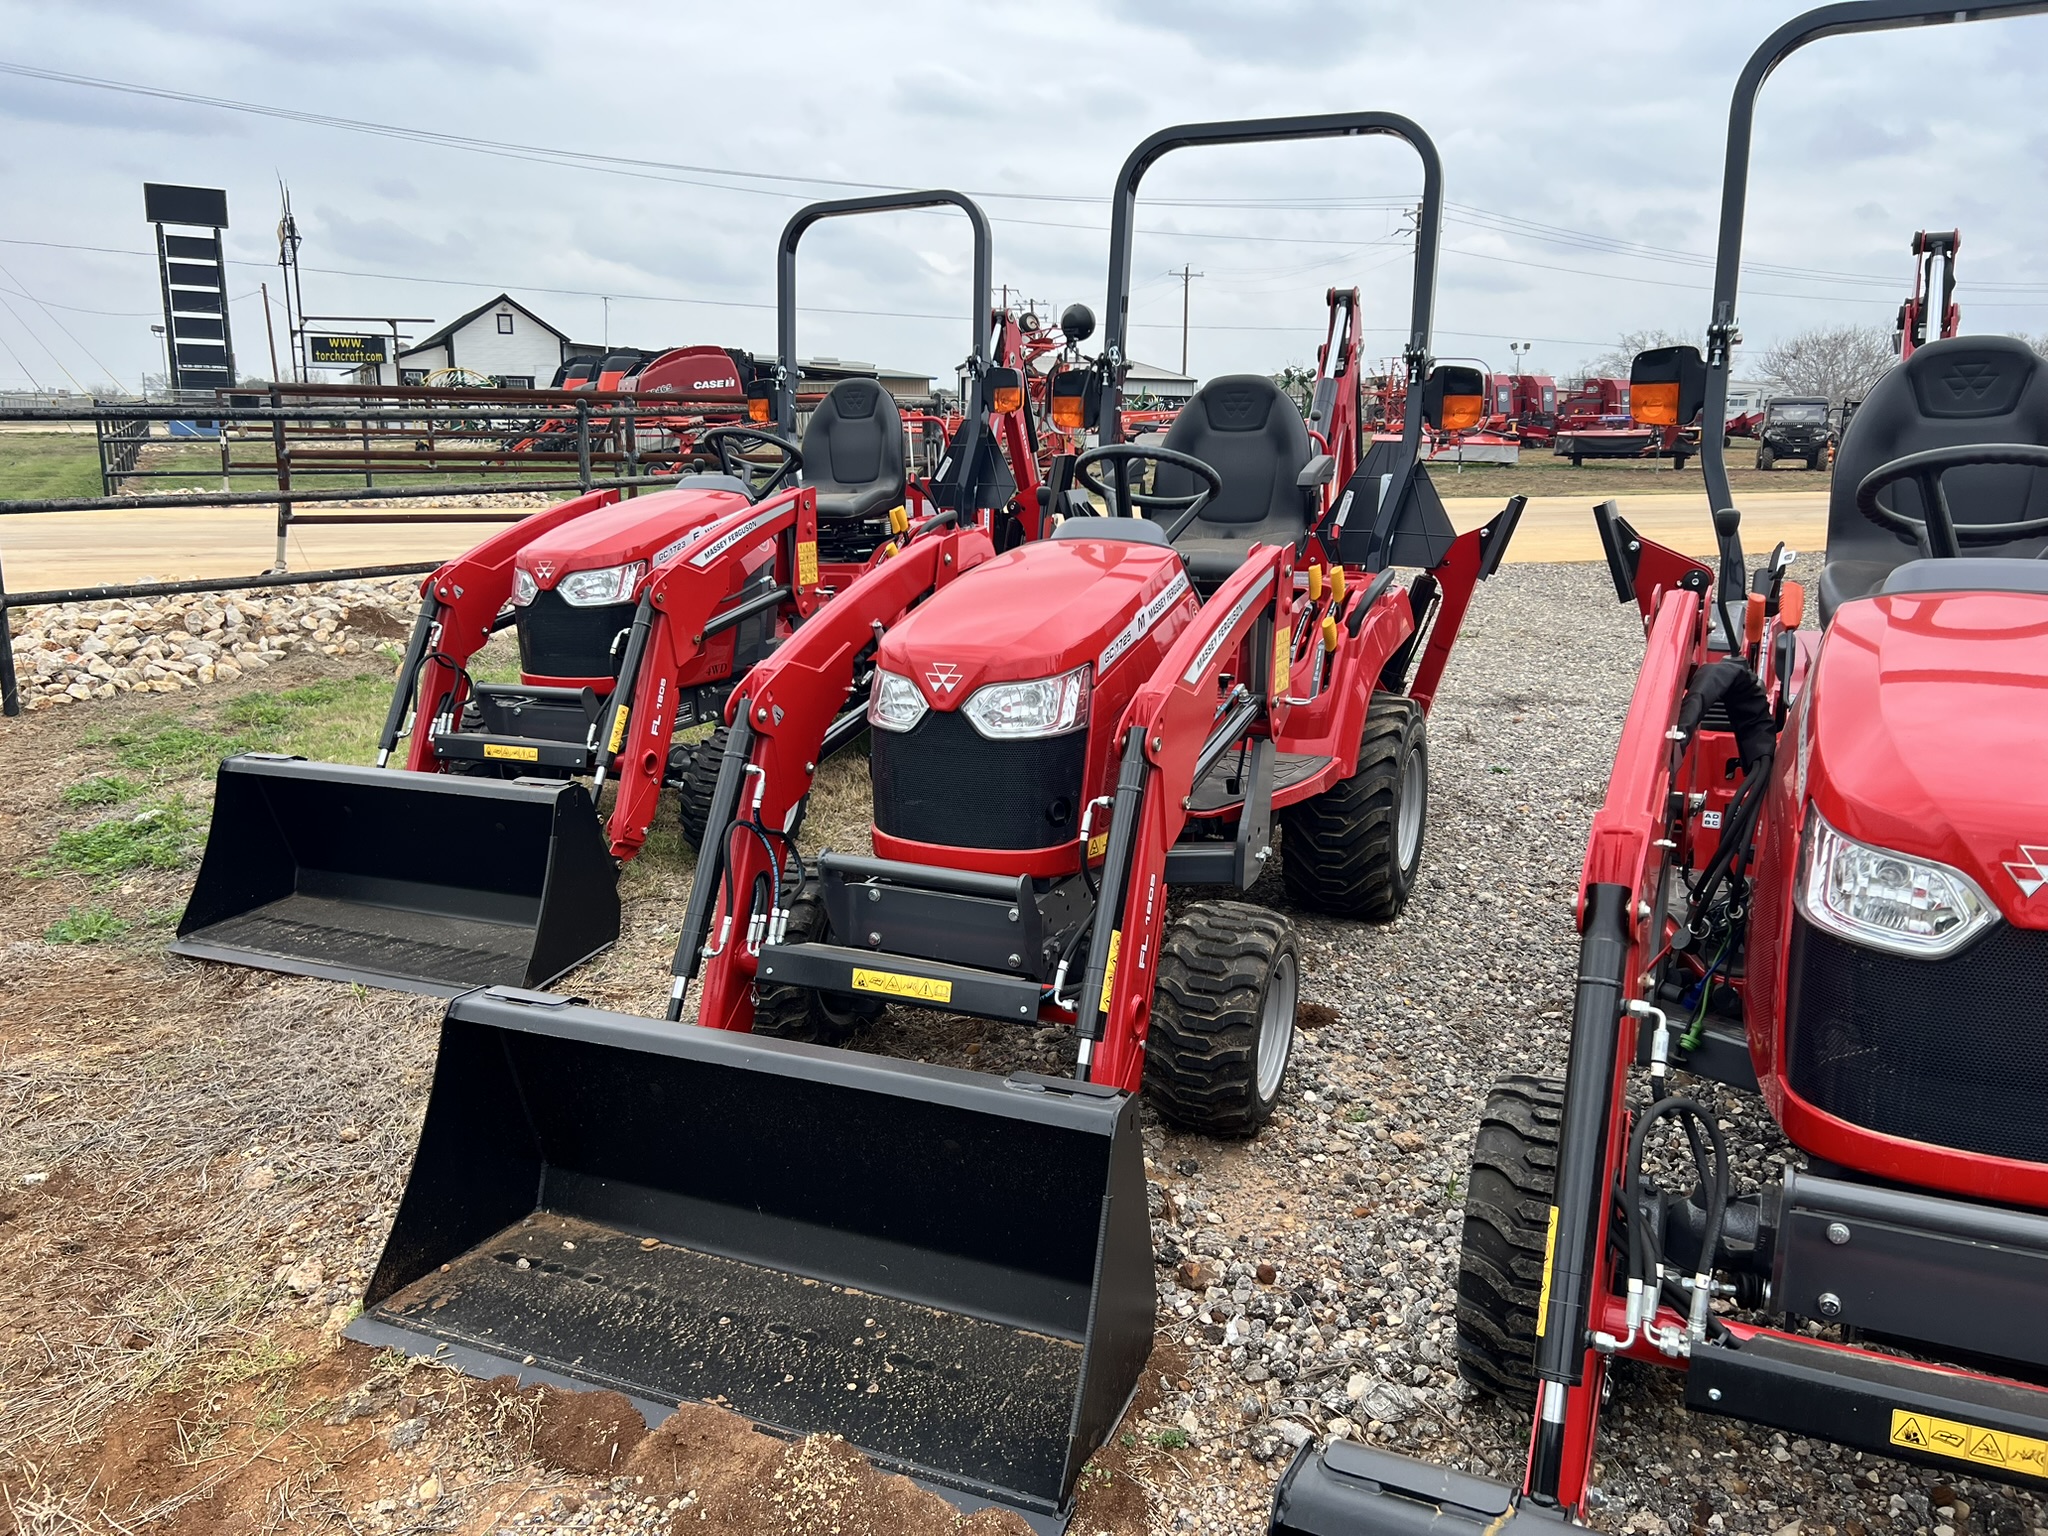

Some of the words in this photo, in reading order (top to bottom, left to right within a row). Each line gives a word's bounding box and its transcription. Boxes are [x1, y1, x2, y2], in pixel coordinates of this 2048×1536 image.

[315, 349, 384, 362] torchcraft.com
[328, 338, 365, 348] www.
[693, 379, 725, 389] CASE
[704, 539, 727, 560] MASSEY
[727, 521, 757, 543] FERGUSON
[1137, 613, 1146, 633] M
[1148, 596, 1166, 621] MASSEY
[1166, 576, 1186, 602] FERGUSON
[1196, 634, 1218, 671] MASSEY
[1218, 603, 1243, 640] FERGUSON
[706, 662, 728, 676] 4WD
[650, 714, 662, 737] FL
[656, 677, 667, 710] 1805
[1138, 934, 1149, 970] FL
[1145, 873, 1156, 926] 1805
